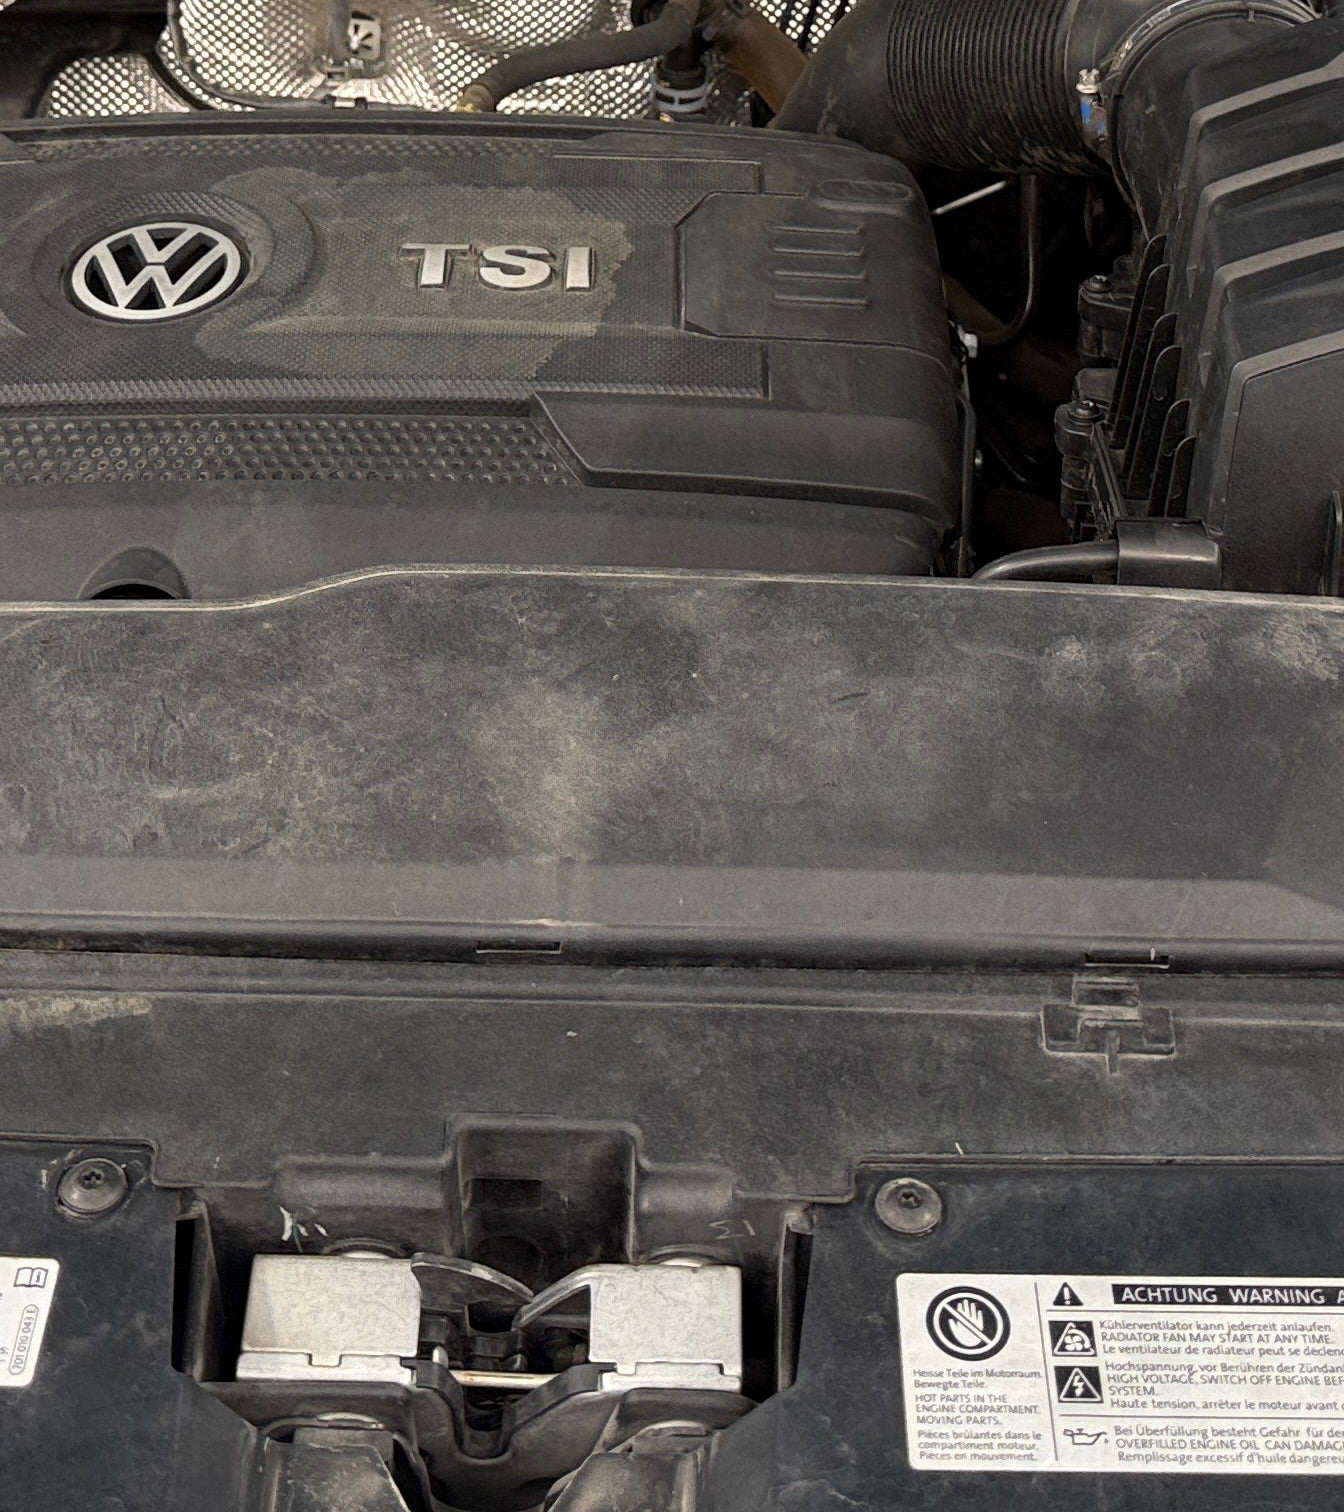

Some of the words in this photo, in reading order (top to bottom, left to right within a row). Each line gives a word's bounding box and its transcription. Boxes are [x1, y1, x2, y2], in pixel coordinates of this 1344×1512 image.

[400, 243, 592, 289] TSI
[1121, 1287, 1218, 1303] ACHTUNG
[1229, 1288, 1326, 1304] WARNING
[1099, 1320, 1193, 1330] Kühlerventilator
[1196, 1321, 1224, 1330] kann
[1227, 1321, 1276, 1333] jederzeit
[1101, 1333, 1160, 1342] RADIATOR
[1163, 1333, 1186, 1343] FAN
[1189, 1334, 1215, 1343] MAY
[1218, 1334, 1253, 1343] START
[1256, 1334, 1271, 1343] AT
[1274, 1334, 1298, 1344] ANY
[1103, 1344, 1116, 1354] Le
[1117, 1345, 1181, 1354] ventilateur
[1184, 1345, 1199, 1355] de
[1202, 1346, 1254, 1355] radiateur
[1258, 1346, 1285, 1358] peut
[913, 1369, 944, 1377] Heisse
[946, 1369, 969, 1377] Teile
[1220, 1363, 1274, 1372] Berühren
[1276, 1364, 1295, 1373] der
[914, 1380, 959, 1390] Bewegte
[1107, 1374, 1139, 1384] HIGH
[1200, 1375, 1246, 1385] SWITCH
[1250, 1376, 1271, 1385] OFF
[1275, 1376, 1321, 1386] ENGINE
[1108, 1387, 1159, 1396] SYSTEM.
[915, 1394, 937, 1402] HOT
[940, 1394, 971, 1403] PARTS
[974, 1395, 985, 1403] IN
[987, 1395, 1008, 1403] THE
[916, 1405, 956, 1413] ENGINE
[1111, 1399, 1147, 1408] Haute
[1202, 1400, 1242, 1409] arrêter
[1244, 1400, 1255, 1409] le
[1258, 1400, 1301, 1409] moteur
[1305, 1401, 1338, 1410] avant
[916, 1416, 963, 1425] MOVING
[1004, 1431, 1029, 1440] dans
[1032, 1432, 1042, 1440] le
[1114, 1426, 1133, 1435] Bei
[1136, 1424, 1208, 1438] Überfüllung
[1211, 1427, 1256, 1436] besteht
[1259, 1427, 1300, 1437] Gefahr
[1306, 1428, 1323, 1437] für
[918, 1441, 993, 1453] compartiment
[1116, 1440, 1187, 1449] OVERFILLED
[1190, 1440, 1236, 1450] ENGINE
[1239, 1441, 1260, 1450] OIL
[1264, 1441, 1290, 1450] CAN
[1118, 1452, 1193, 1465] Remplissage
[1196, 1453, 1243, 1463] excessif
[1247, 1454, 1287, 1463] d'huile
